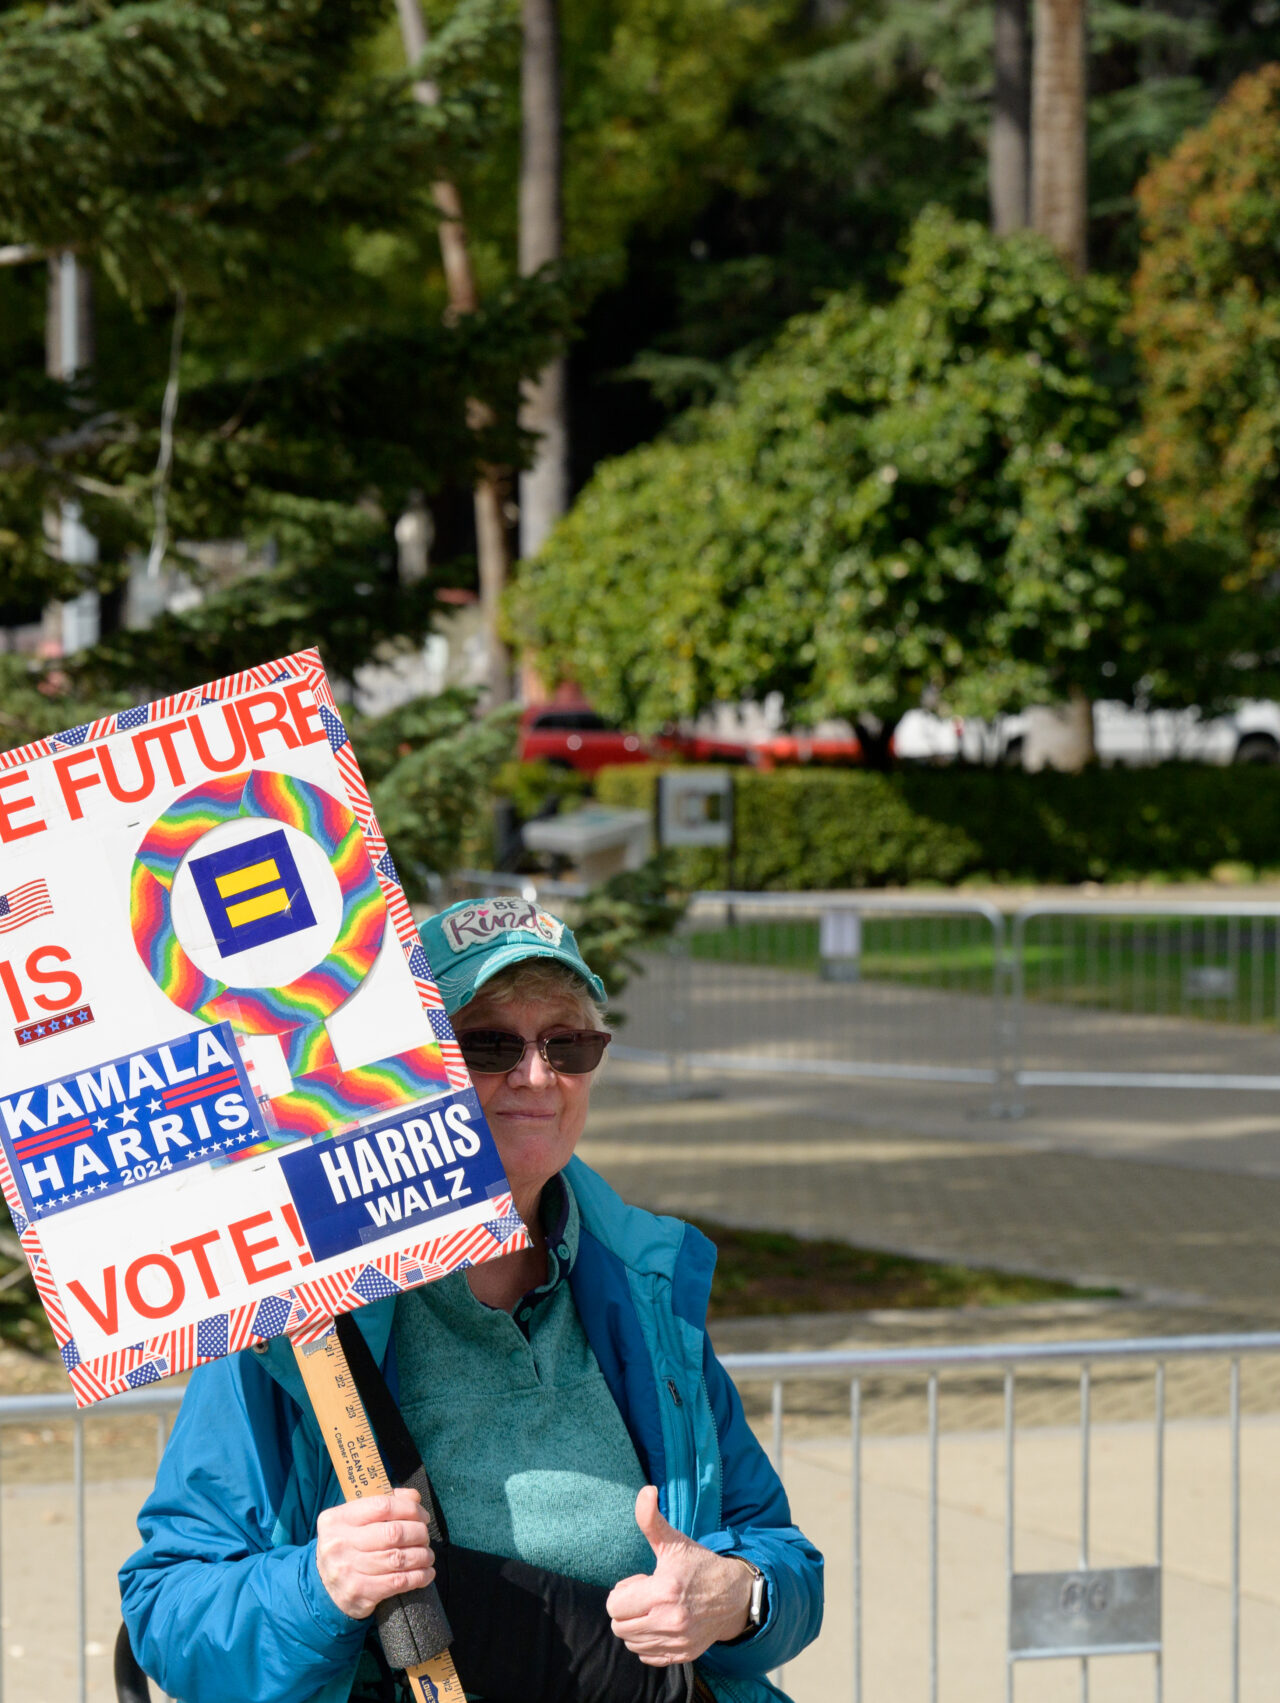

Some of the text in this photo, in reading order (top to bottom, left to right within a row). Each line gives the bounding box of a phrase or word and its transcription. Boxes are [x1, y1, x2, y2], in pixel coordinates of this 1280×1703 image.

[52, 680, 329, 823] FUTURE
[493, 901, 519, 910] BE
[450, 904, 552, 945] Kind
[21, 1093, 250, 1198] HARRIS
[319, 1103, 481, 1205] HARRIS
[119, 1155, 173, 1186] 2024
[364, 1167, 472, 1228] WALZ
[66, 1203, 316, 1337] VOTE!
[325, 1345, 335, 1357] 21
[334, 1374, 346, 1389] 22
[345, 1405, 356, 1419] 23
[334, 1432, 356, 1484] Cleaner Rags
[356, 1435, 365, 1449] 24
[347, 1440, 364, 1473] CLEAN
[358, 1475, 369, 1487] UP
[366, 1465, 378, 1480] 25
[442, 1679, 452, 1692] 32
